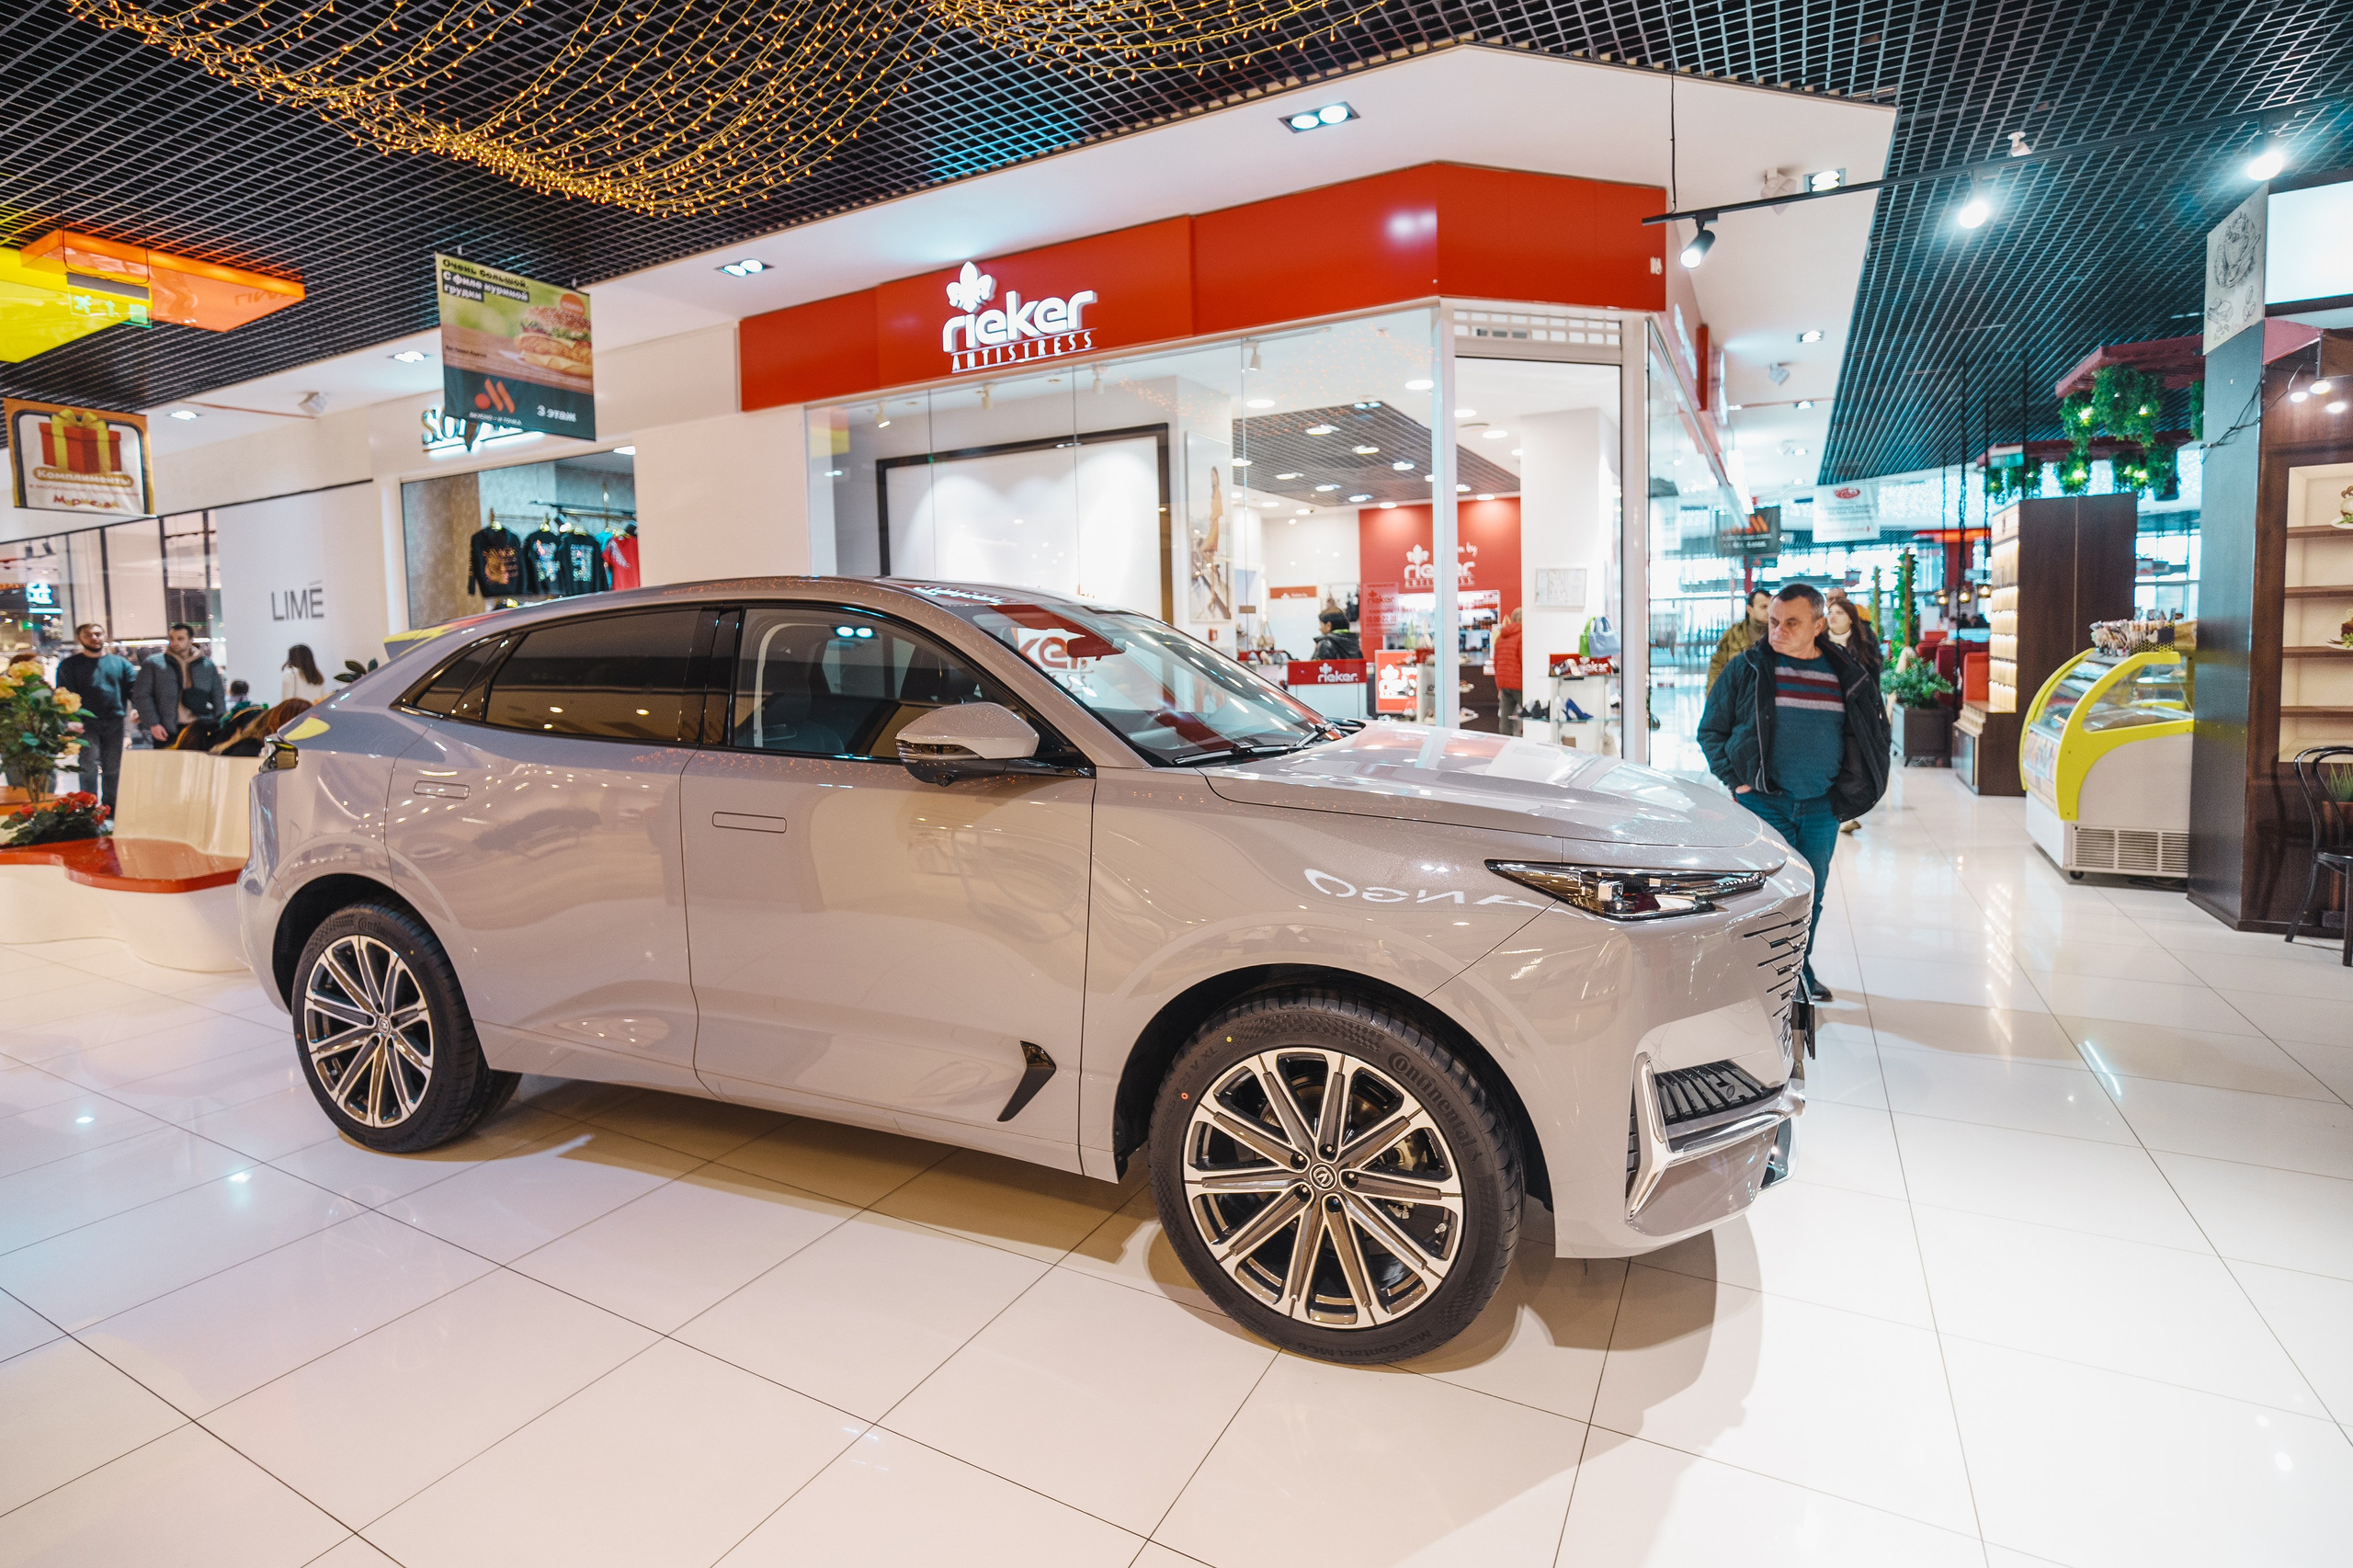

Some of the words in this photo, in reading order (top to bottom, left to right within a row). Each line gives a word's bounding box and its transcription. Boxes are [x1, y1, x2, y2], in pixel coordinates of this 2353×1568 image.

[443, 283, 483, 301] грудки
[942, 290, 1097, 353] rieker
[952, 331, 1092, 371] ANTISTRESS
[536, 404, 546, 417] 3
[547, 408, 577, 423] этаж
[270, 579, 324, 620] LIMÉ
[1388, 1051, 1478, 1151] Continental
[1337, 1329, 1432, 1358] MaxContact
